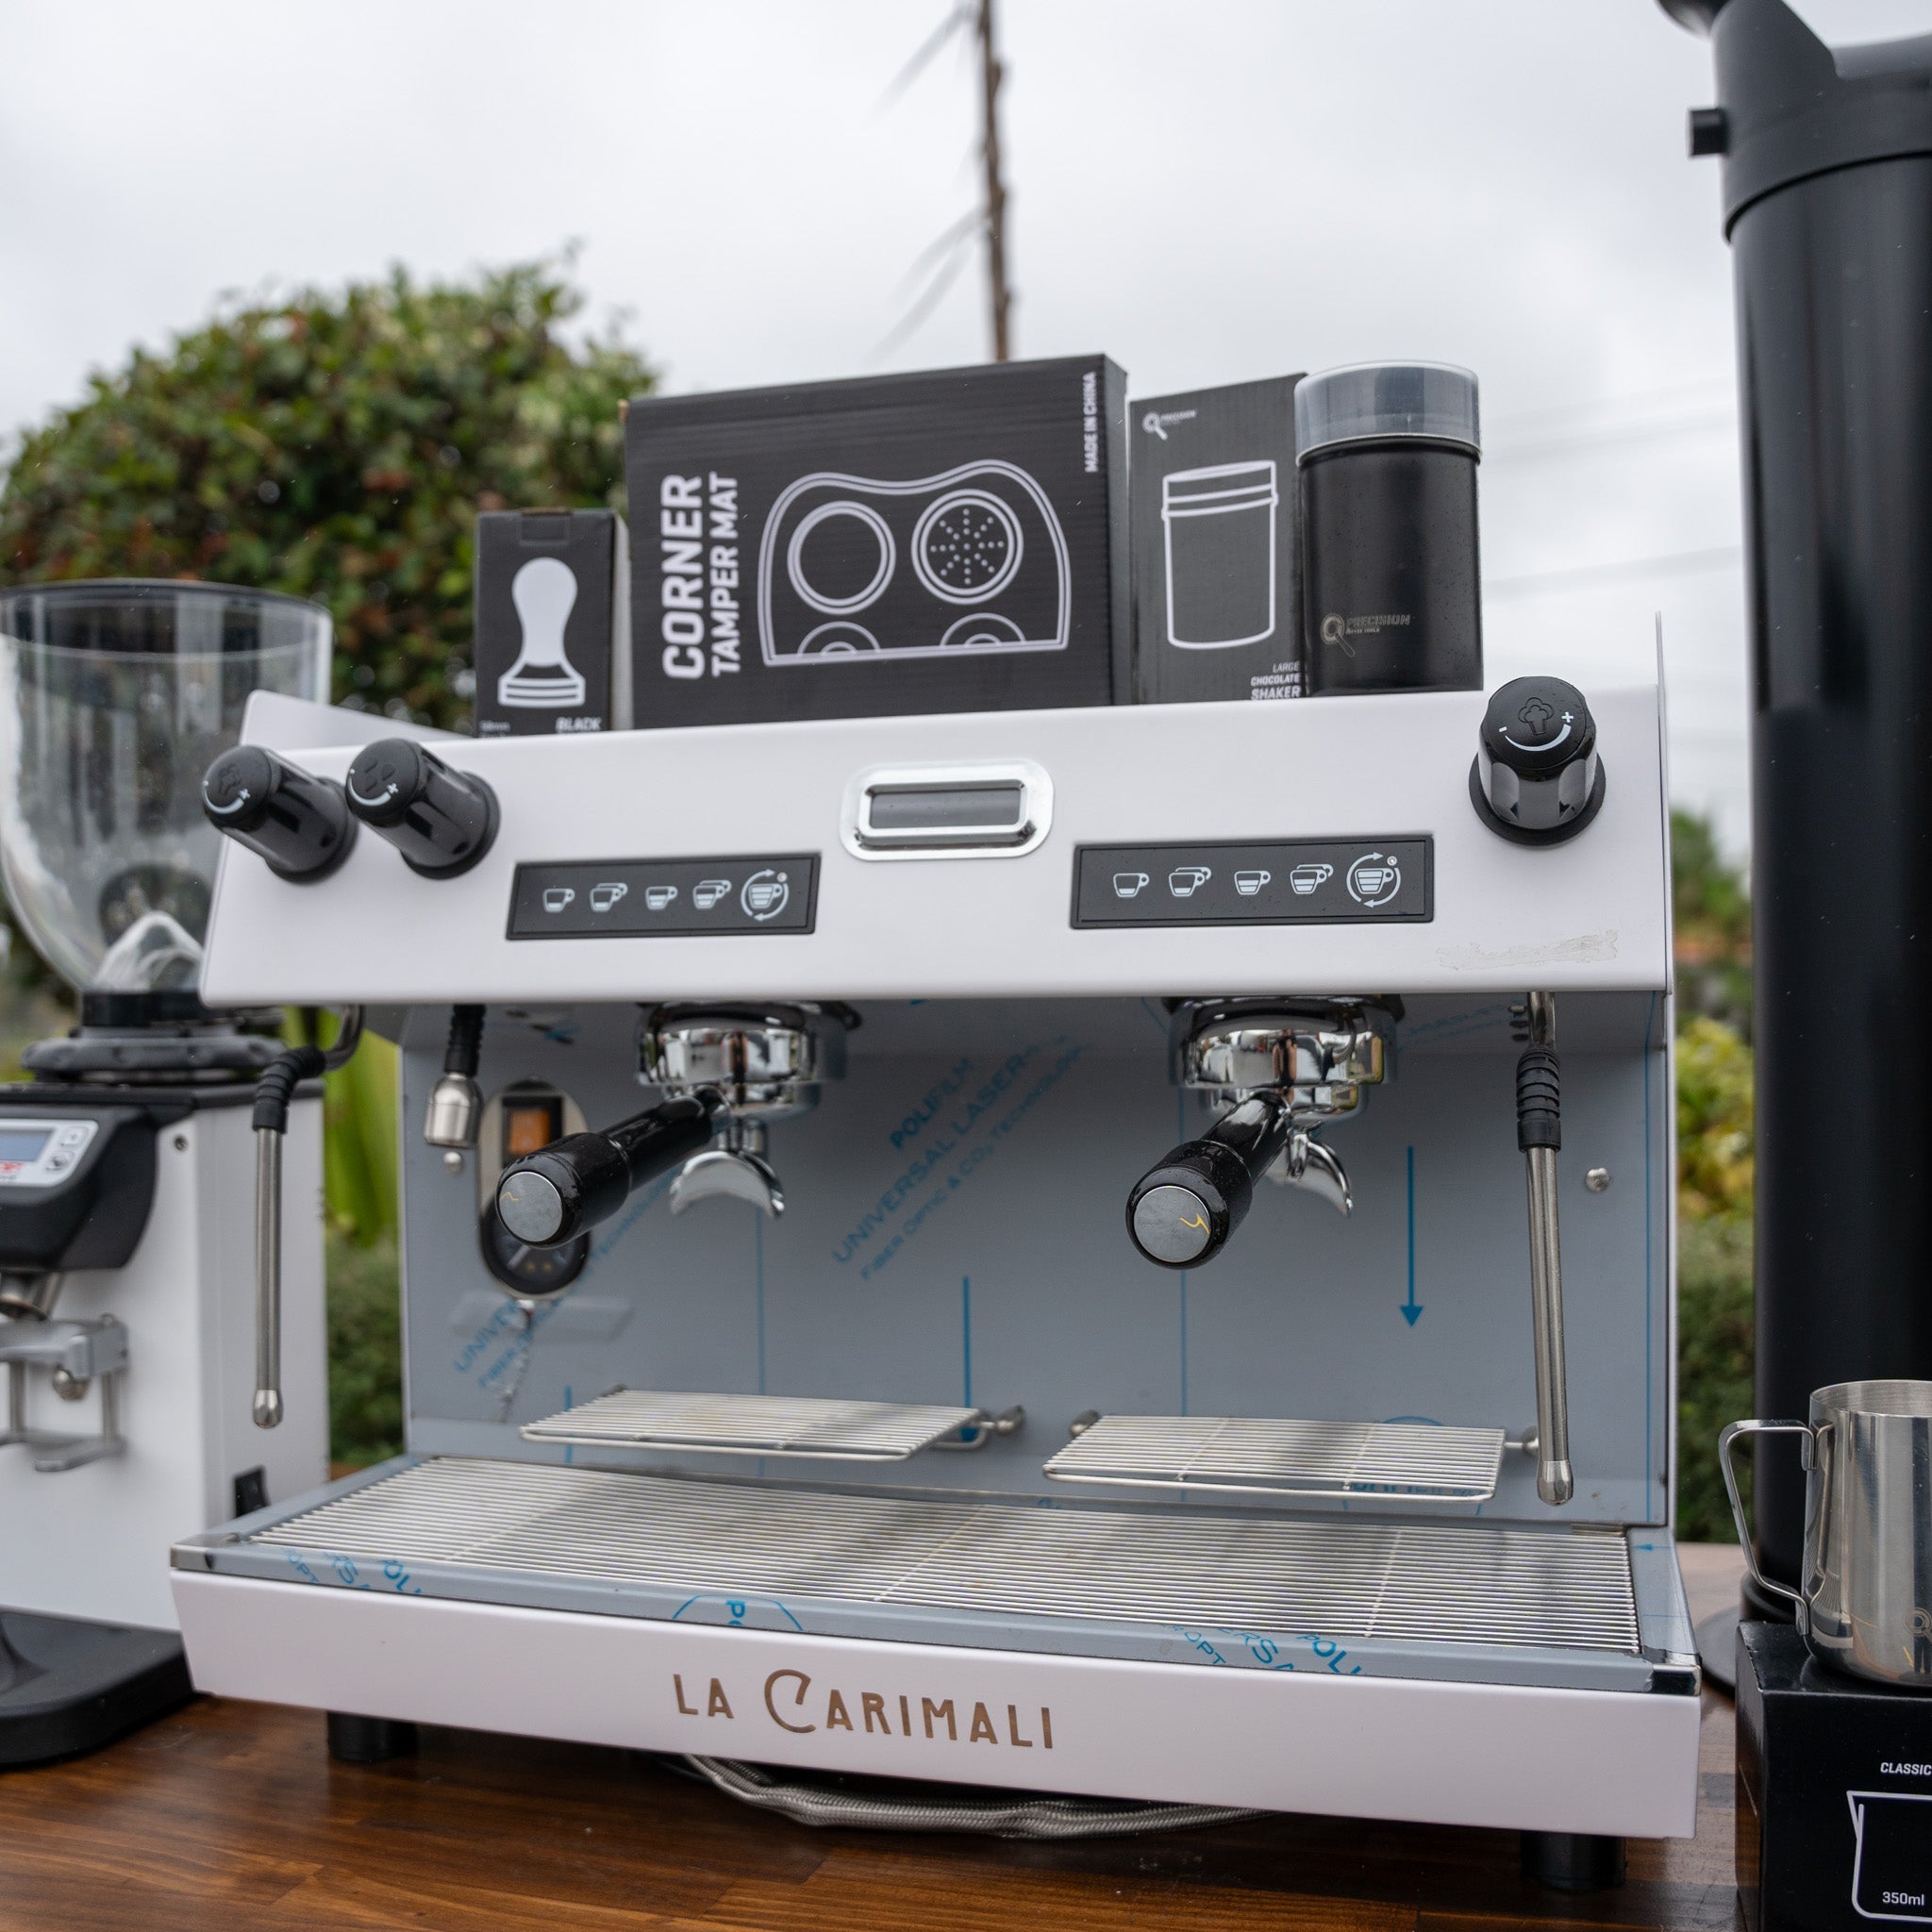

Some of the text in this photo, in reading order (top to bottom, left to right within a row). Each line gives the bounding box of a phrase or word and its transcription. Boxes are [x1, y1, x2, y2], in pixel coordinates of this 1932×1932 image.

[1082, 371, 1098, 473] MADE IN CHINA
[661, 475, 706, 679] CORNER
[708, 471, 741, 678] TAMPER MAT
[1273, 661, 1300, 674] LARGE
[1250, 672, 1301, 687] CHOCOLATE
[1251, 685, 1301, 700] SHAKER
[555, 716, 602, 733] BLACK
[832, 1139, 956, 1262] UNIVERSAL
[673, 1668, 1054, 1749] LA CARIMALI
[1880, 1762, 1932, 1775] CLASSIC
[1882, 1890, 1925, 1907] 350ml
